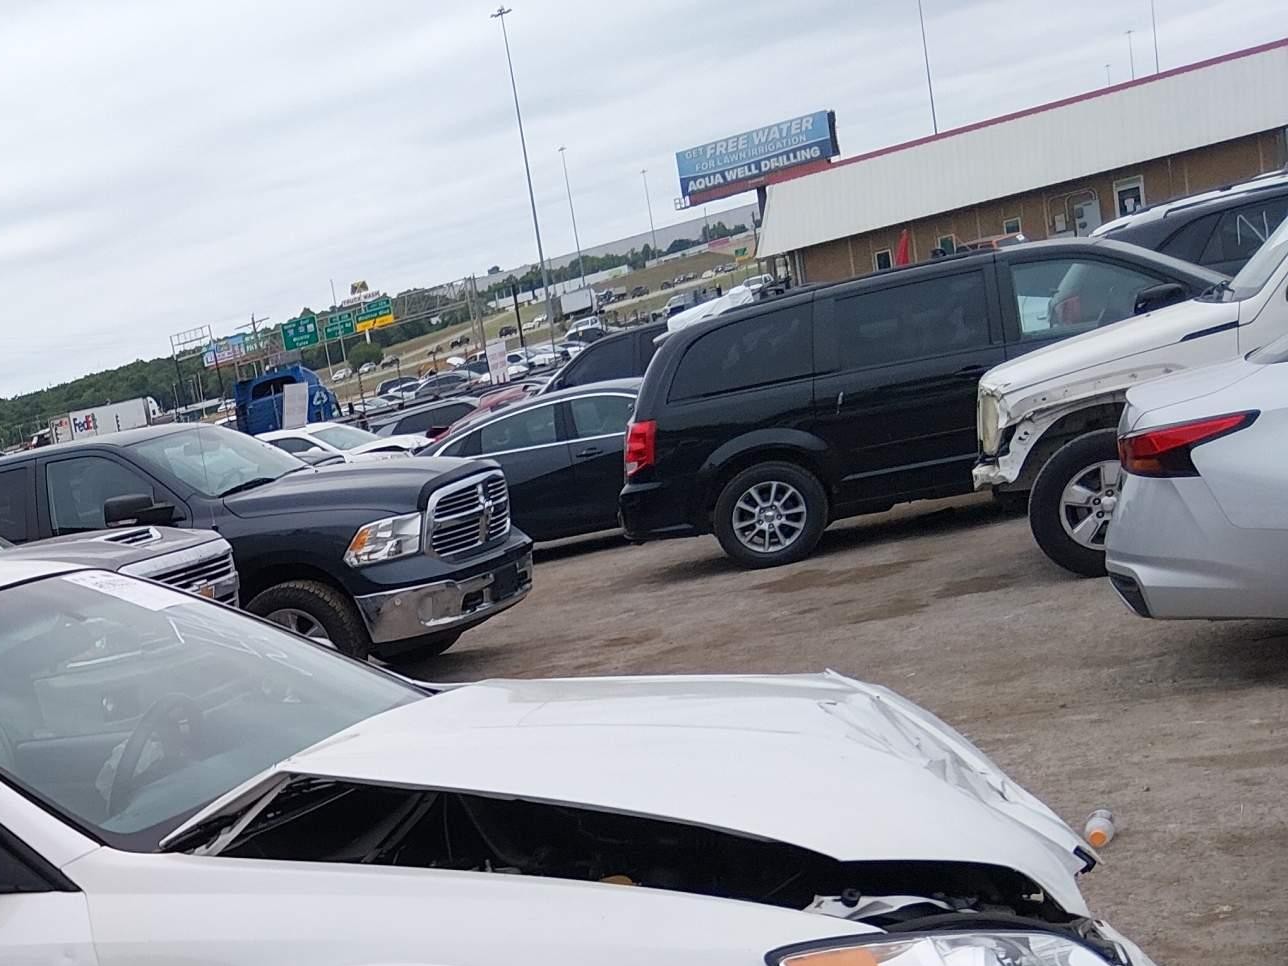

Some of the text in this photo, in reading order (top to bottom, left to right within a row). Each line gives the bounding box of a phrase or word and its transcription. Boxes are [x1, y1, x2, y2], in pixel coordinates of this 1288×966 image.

[685, 116, 814, 161] GET FREE WATER
[696, 134, 807, 172] FOR LAWN IRRIGATION
[687, 146, 821, 192] AQUA WELL DRILLING
[73, 414, 93, 433] FedE
